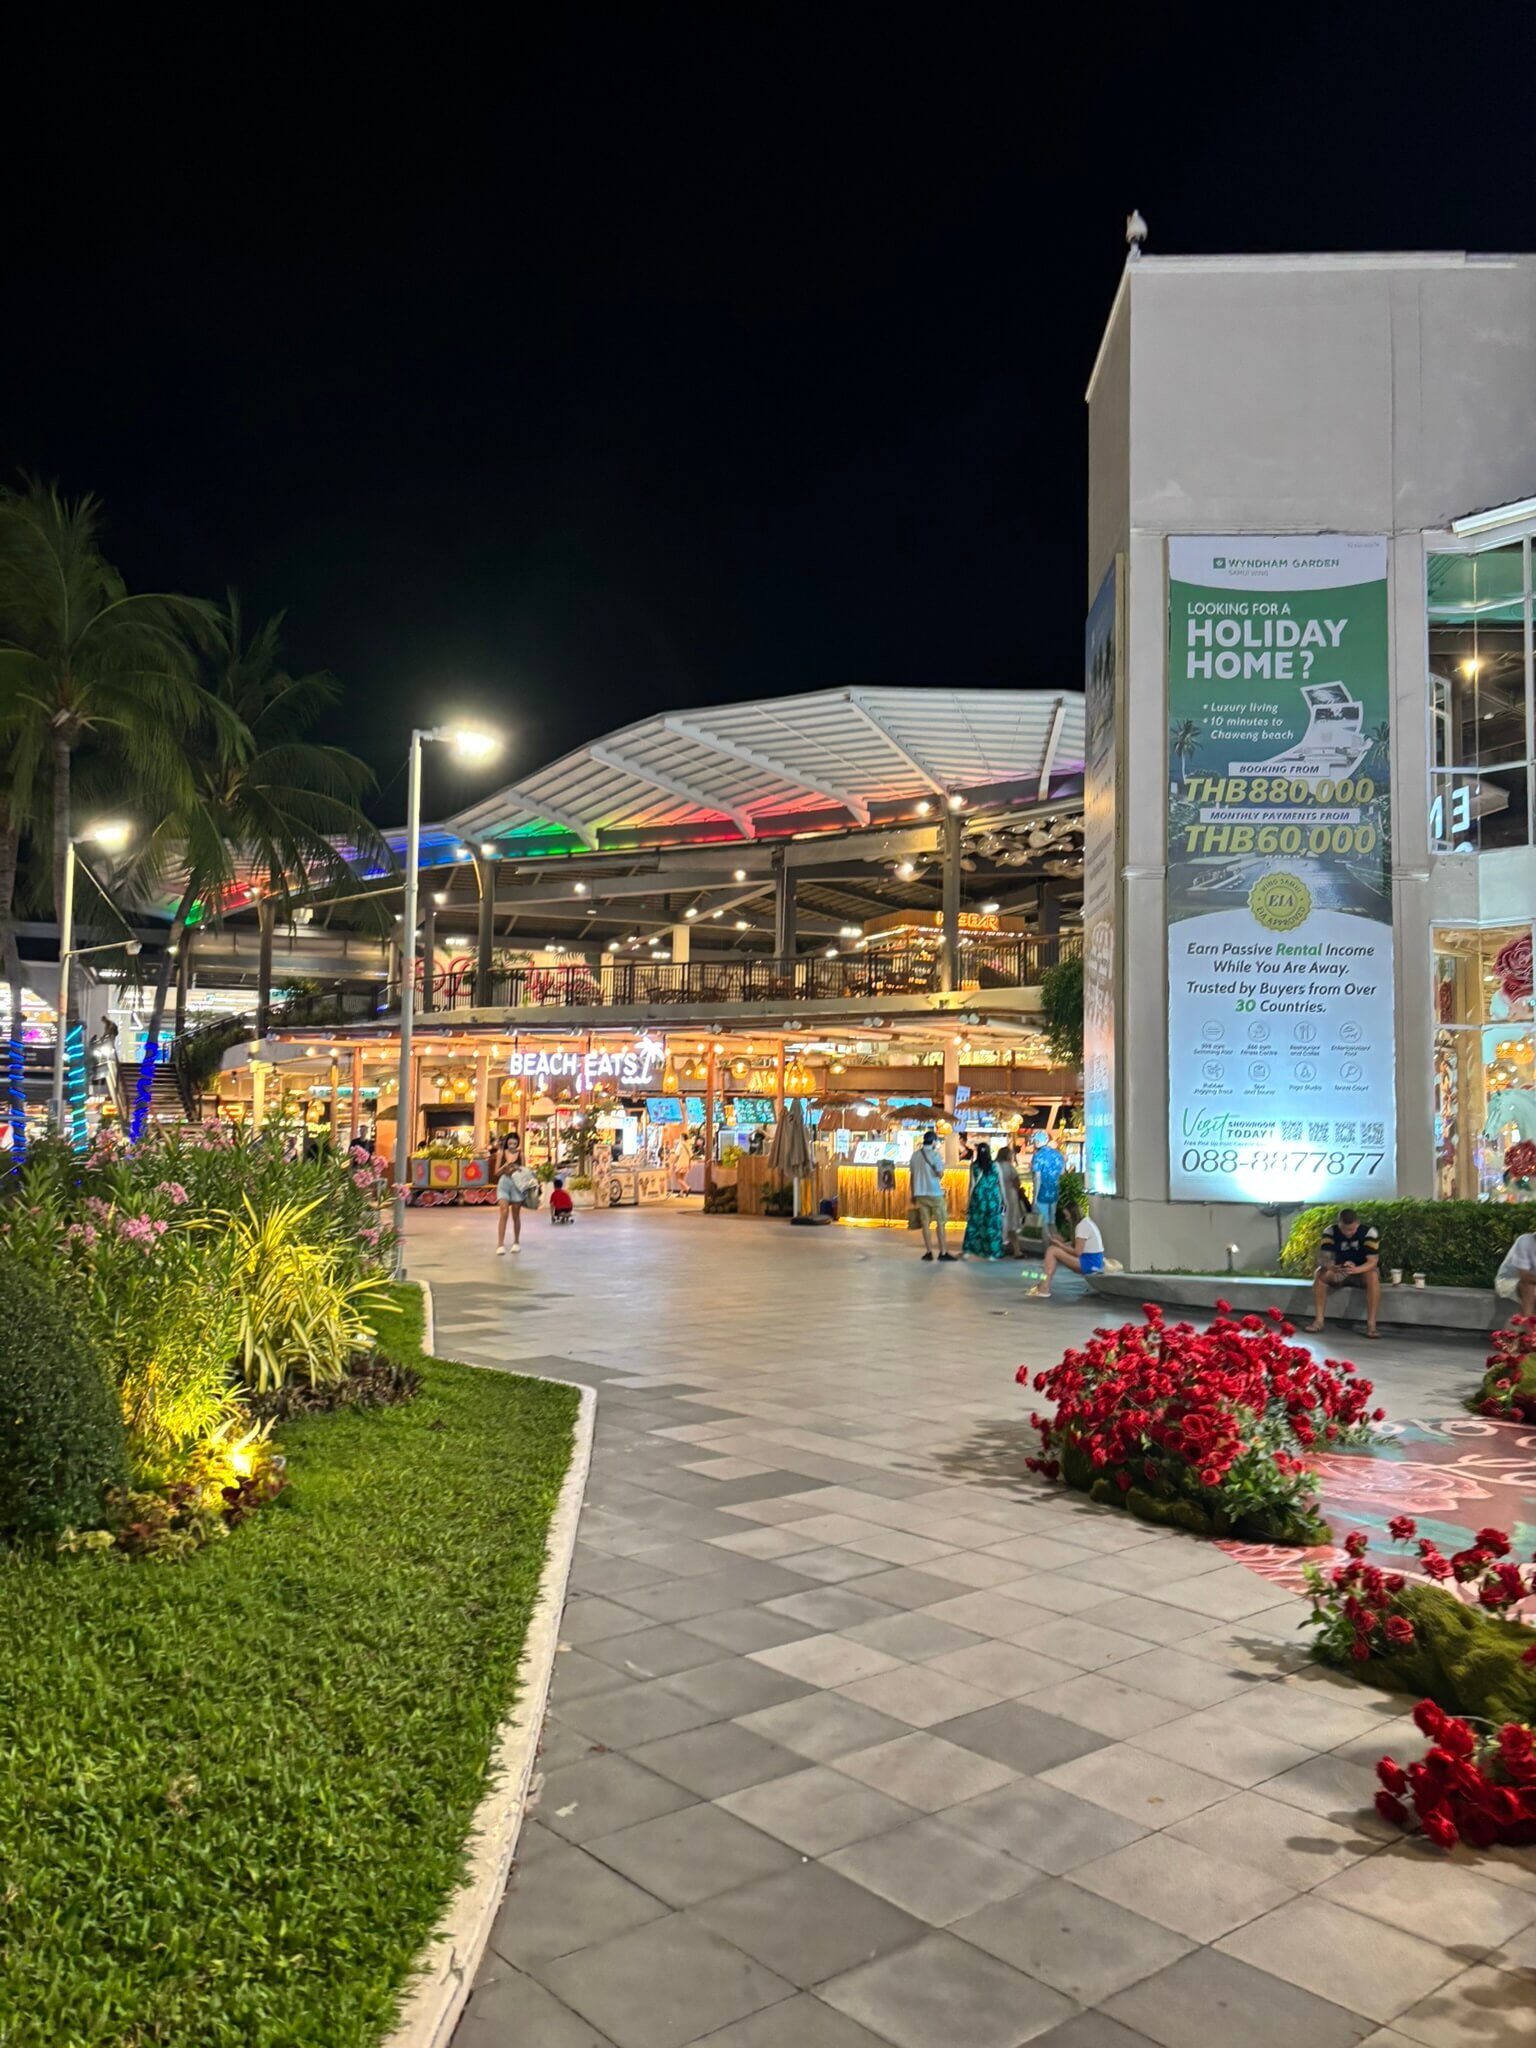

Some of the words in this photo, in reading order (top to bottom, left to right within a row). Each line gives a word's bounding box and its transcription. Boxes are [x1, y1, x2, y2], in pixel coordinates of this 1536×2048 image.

[1229, 559, 1288, 568] WYNDHAM
[1292, 558, 1339, 568] GARDEN
[1187, 602, 1249, 615] LOOKING
[1252, 602, 1279, 615] FOR
[1281, 602, 1291, 615] A
[1187, 619, 1348, 647] HOLIDAY
[1211, 702, 1246, 714] Luxury
[1250, 702, 1278, 714] living
[1211, 717, 1224, 727] 10
[1227, 717, 1268, 726] minutes
[1272, 717, 1283, 726] to
[1211, 730, 1258, 741] Chaweng
[1262, 730, 1294, 740] beach
[1239, 765, 1287, 774] BOOKING
[1290, 765, 1320, 774] FROM
[1184, 777, 1375, 805] THB880,000
[1210, 812, 1259, 821] MONTHLY
[1262, 812, 1317, 821] PAYMENTS
[1320, 812, 1350, 821] FROM
[1185, 825, 1376, 855] THB60,000
[1269, 895, 1293, 907] EIA
[1187, 943, 1218, 955] Earn
[1222, 943, 1273, 956] Passive
[1276, 943, 1323, 956] Rental
[1325, 944, 1375, 956] Income
[1213, 960, 1251, 973] While
[1255, 961, 1280, 973] You
[1283, 961, 1306, 974] Are
[1309, 961, 1350, 977] Away.
[1187, 981, 1236, 994] Trusted
[1239, 981, 1257, 997] by
[1260, 983, 1305, 998] Buyers
[1308, 982, 1341, 995] from
[1344, 983, 1376, 996] Over
[1235, 999, 1256, 1012] 30
[1260, 1000, 1327, 1013] Countries.
[510, 1053, 577, 1076] BEACH
[584, 1052, 637, 1076] EATS
[1182, 1107, 1240, 1140] Visit
